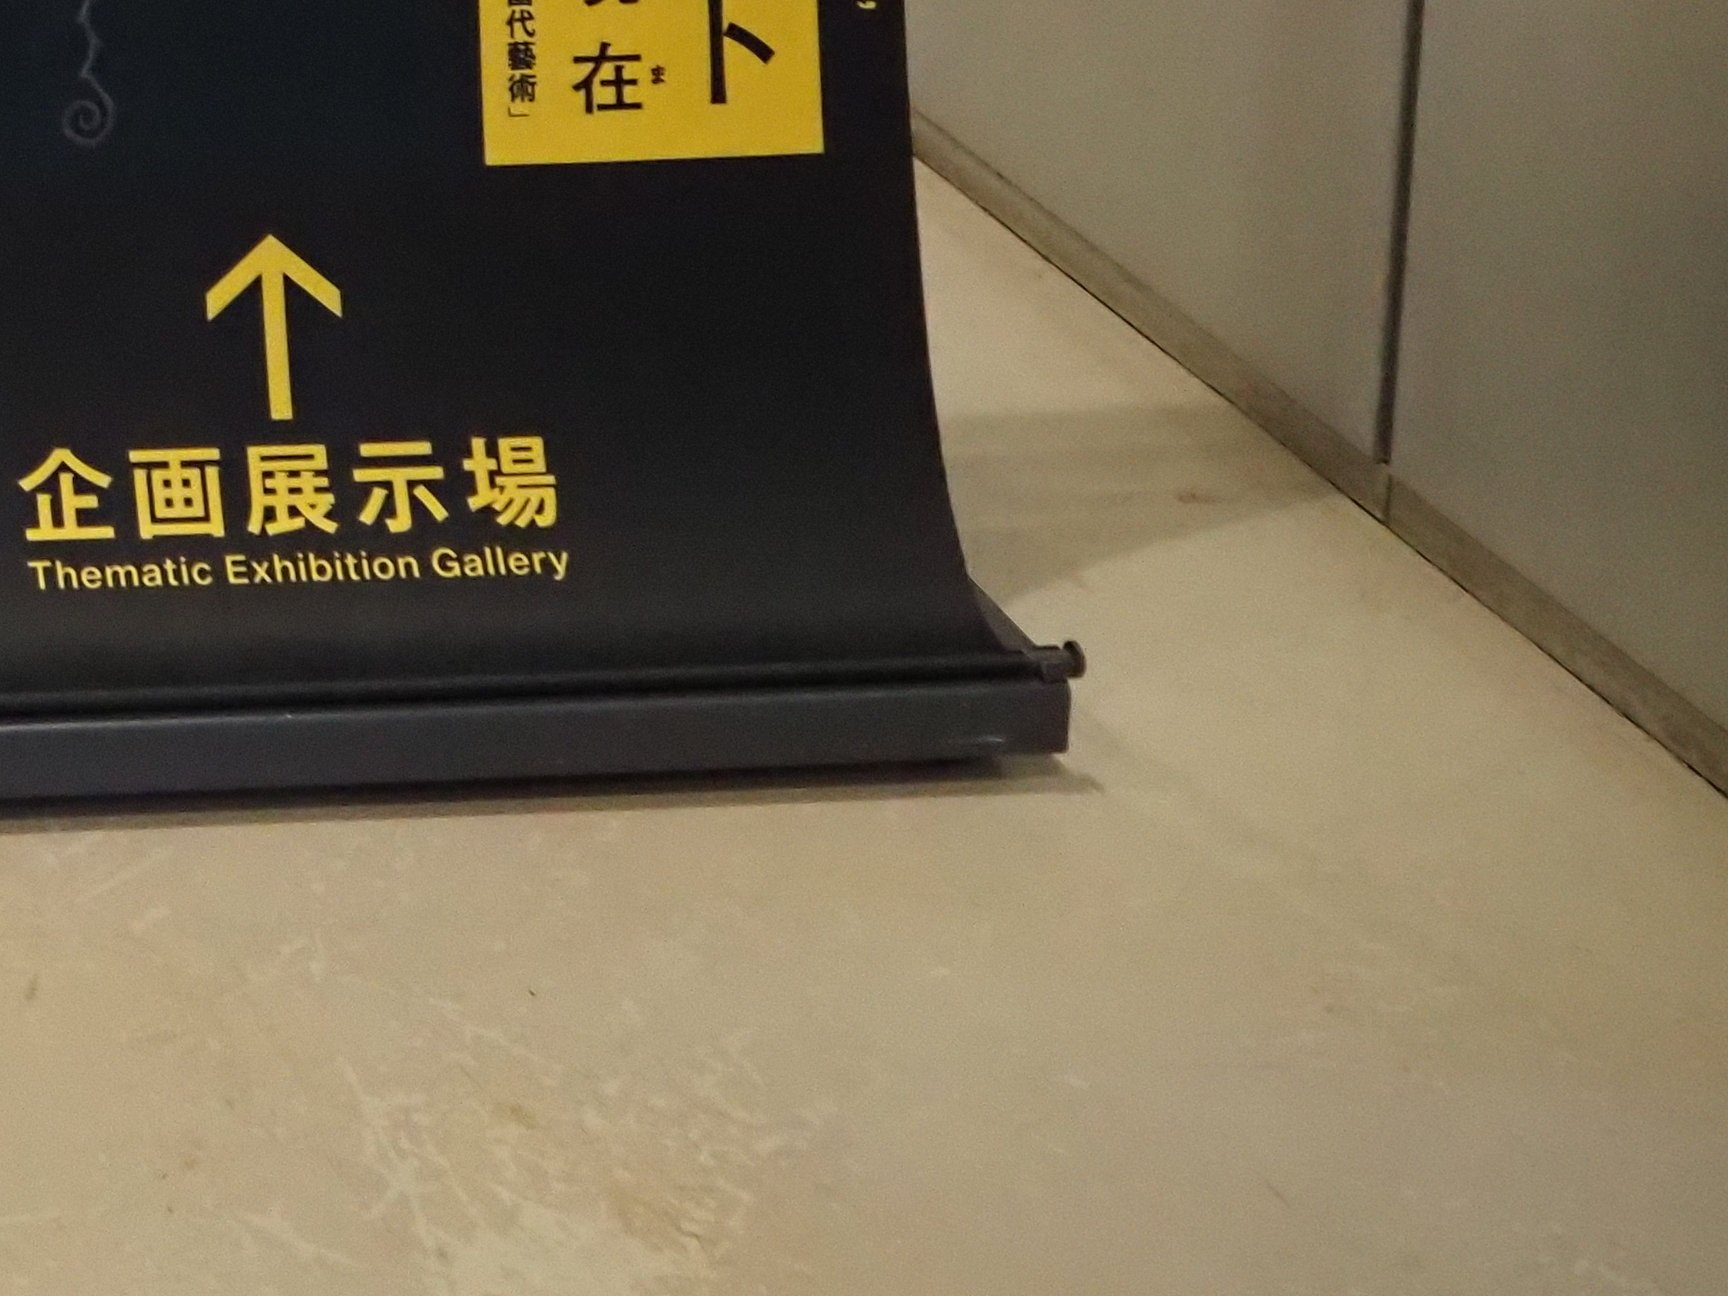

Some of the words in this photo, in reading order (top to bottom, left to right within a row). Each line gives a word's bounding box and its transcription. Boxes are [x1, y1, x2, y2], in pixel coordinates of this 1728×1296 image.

[18, 435, 557, 541] 企画展示場
[27, 555, 213, 591] Thematic
[226, 550, 420, 586] Exhibition
[431, 544, 569, 581] Gallery
